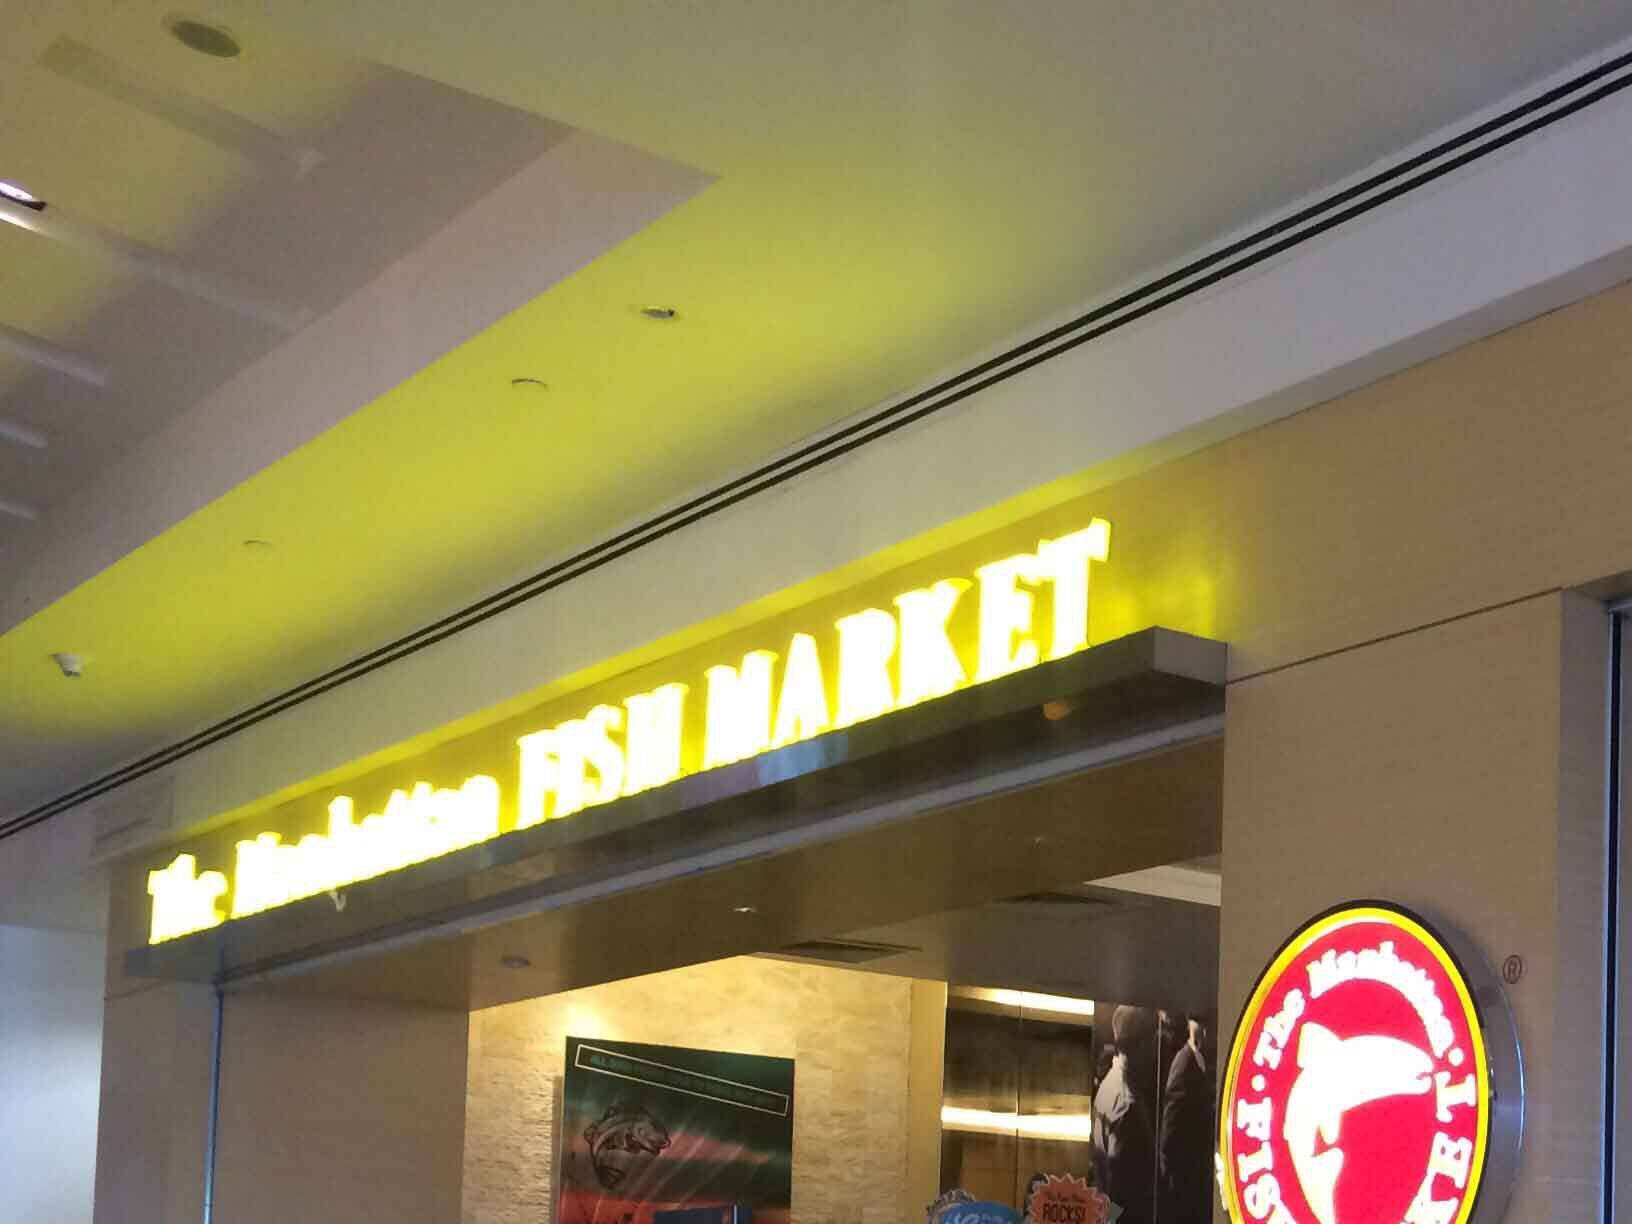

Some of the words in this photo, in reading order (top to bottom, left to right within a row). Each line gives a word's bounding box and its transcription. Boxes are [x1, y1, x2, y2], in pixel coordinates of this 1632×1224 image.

[516, 682, 689, 831] FISH
[704, 517, 1111, 770] MARKET
[1253, 988, 1305, 1070] The
[1306, 940, 1456, 1058] Manhattan
